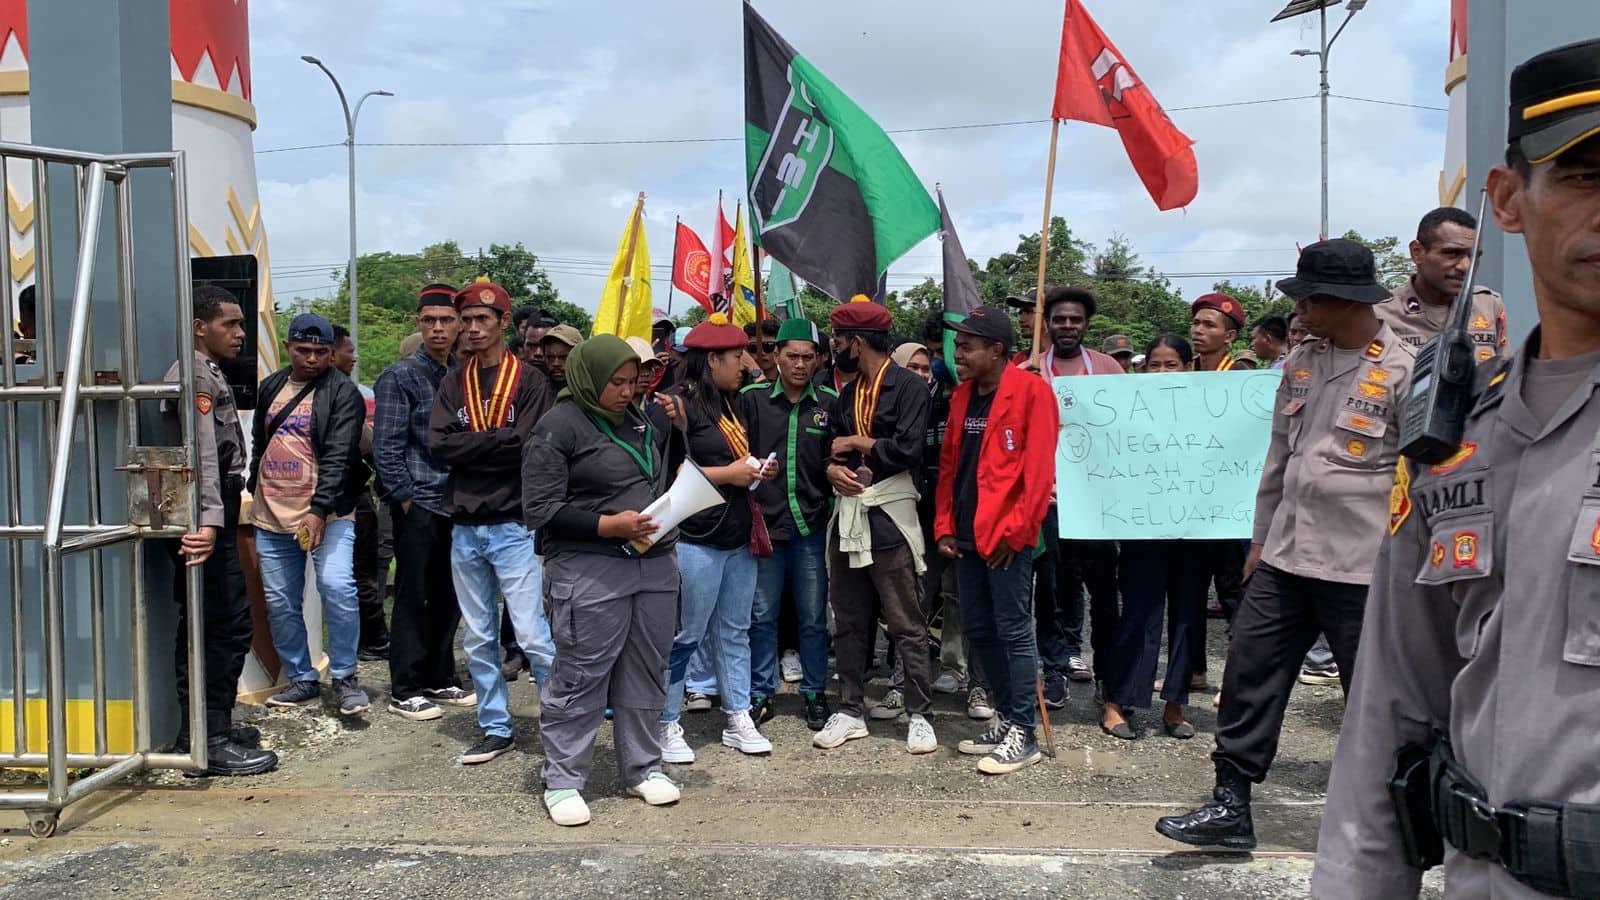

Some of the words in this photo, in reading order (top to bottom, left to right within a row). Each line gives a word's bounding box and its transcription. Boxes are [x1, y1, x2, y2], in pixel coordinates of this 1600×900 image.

[1472, 333, 1496, 343] OLRI
[1087, 386, 1229, 426] SATU
[1346, 397, 1388, 416] POLRI
[1106, 430, 1225, 456] NEGARA
[1087, 461, 1181, 481] KALAH
[1201, 460, 1264, 478] SAMA
[1147, 479, 1216, 495] SATU
[1420, 480, 1485, 518] AMLI
[1101, 500, 1252, 529] KELUARG
